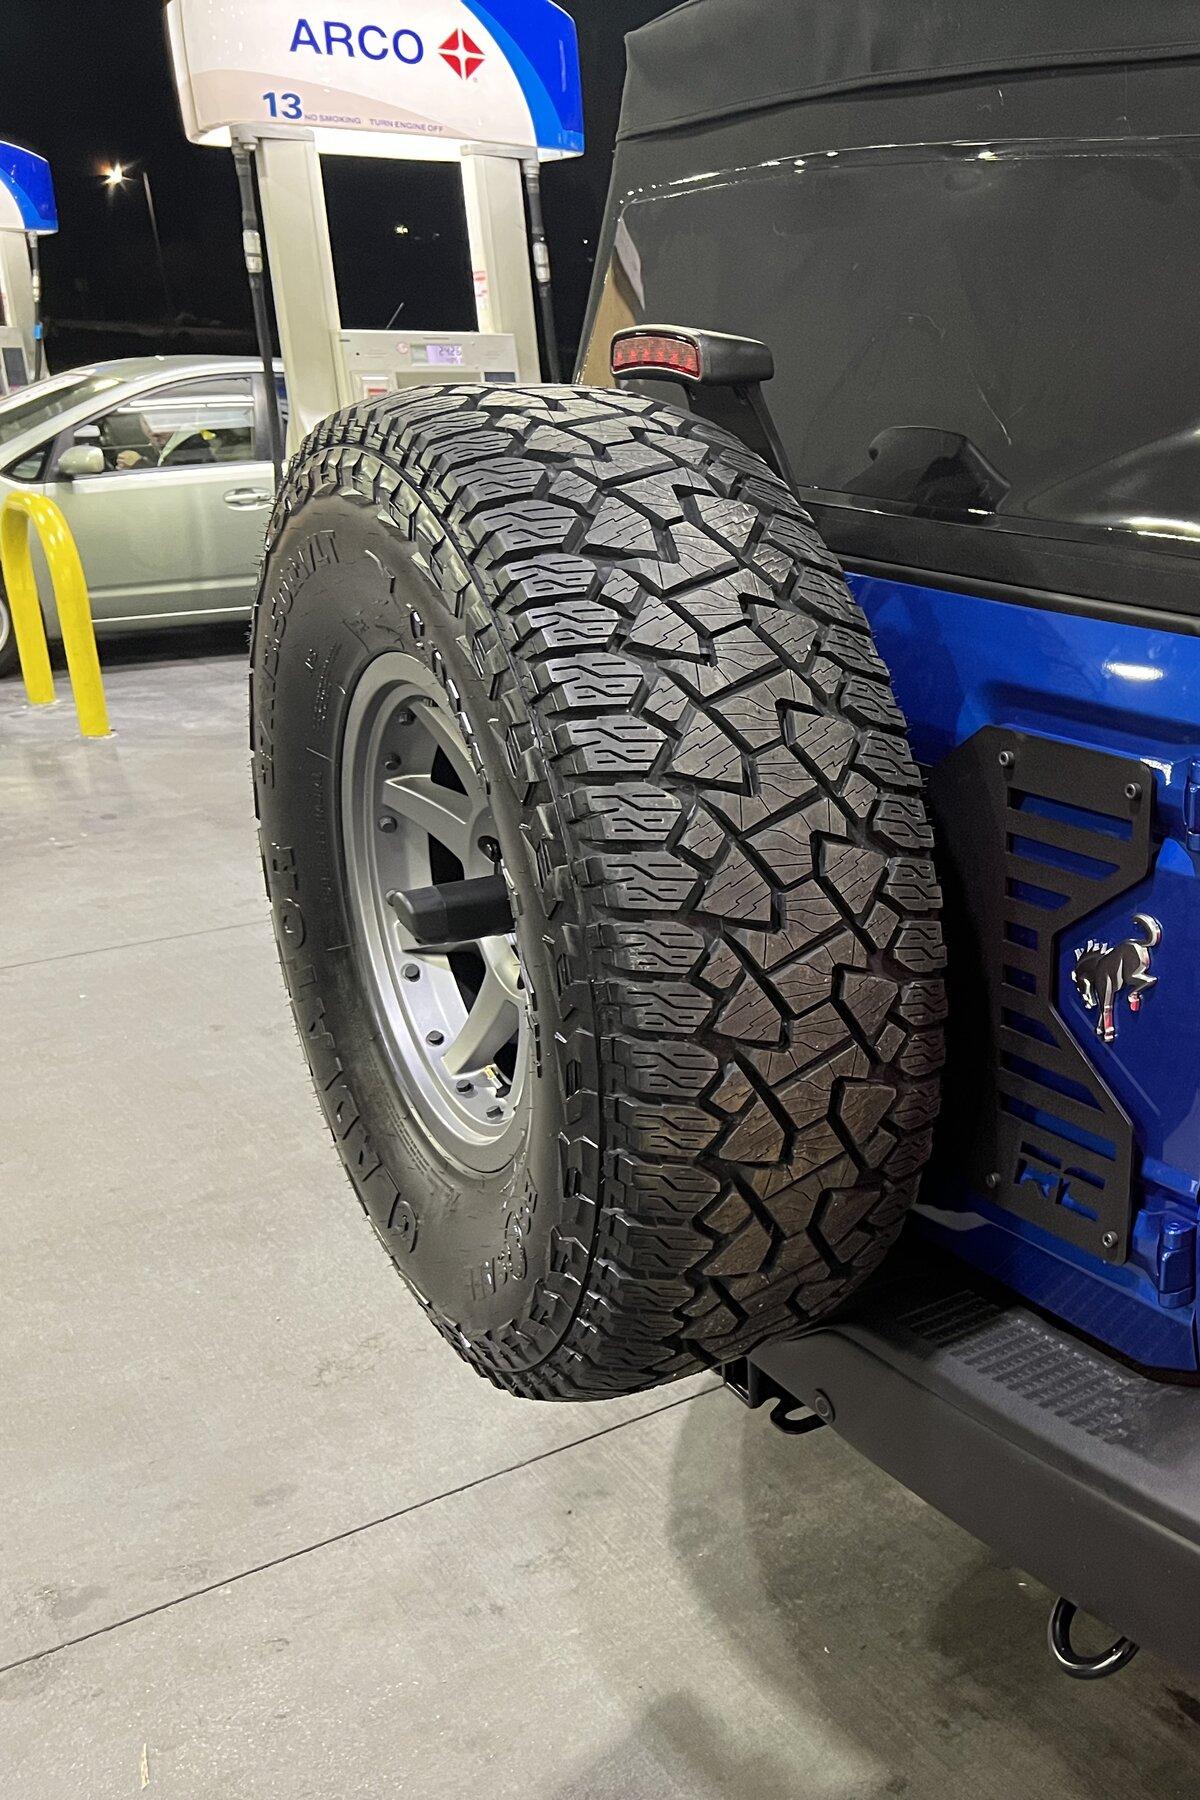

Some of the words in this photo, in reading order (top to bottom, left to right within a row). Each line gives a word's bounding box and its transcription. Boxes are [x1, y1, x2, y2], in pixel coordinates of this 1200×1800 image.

[290, 18, 424, 65] ARCO
[262, 92, 303, 120] 13
[319, 115, 362, 125] SMOKING
[369, 119, 394, 128] TURN
[394, 121, 426, 131] ENGINE
[428, 124, 444, 133] OFF
